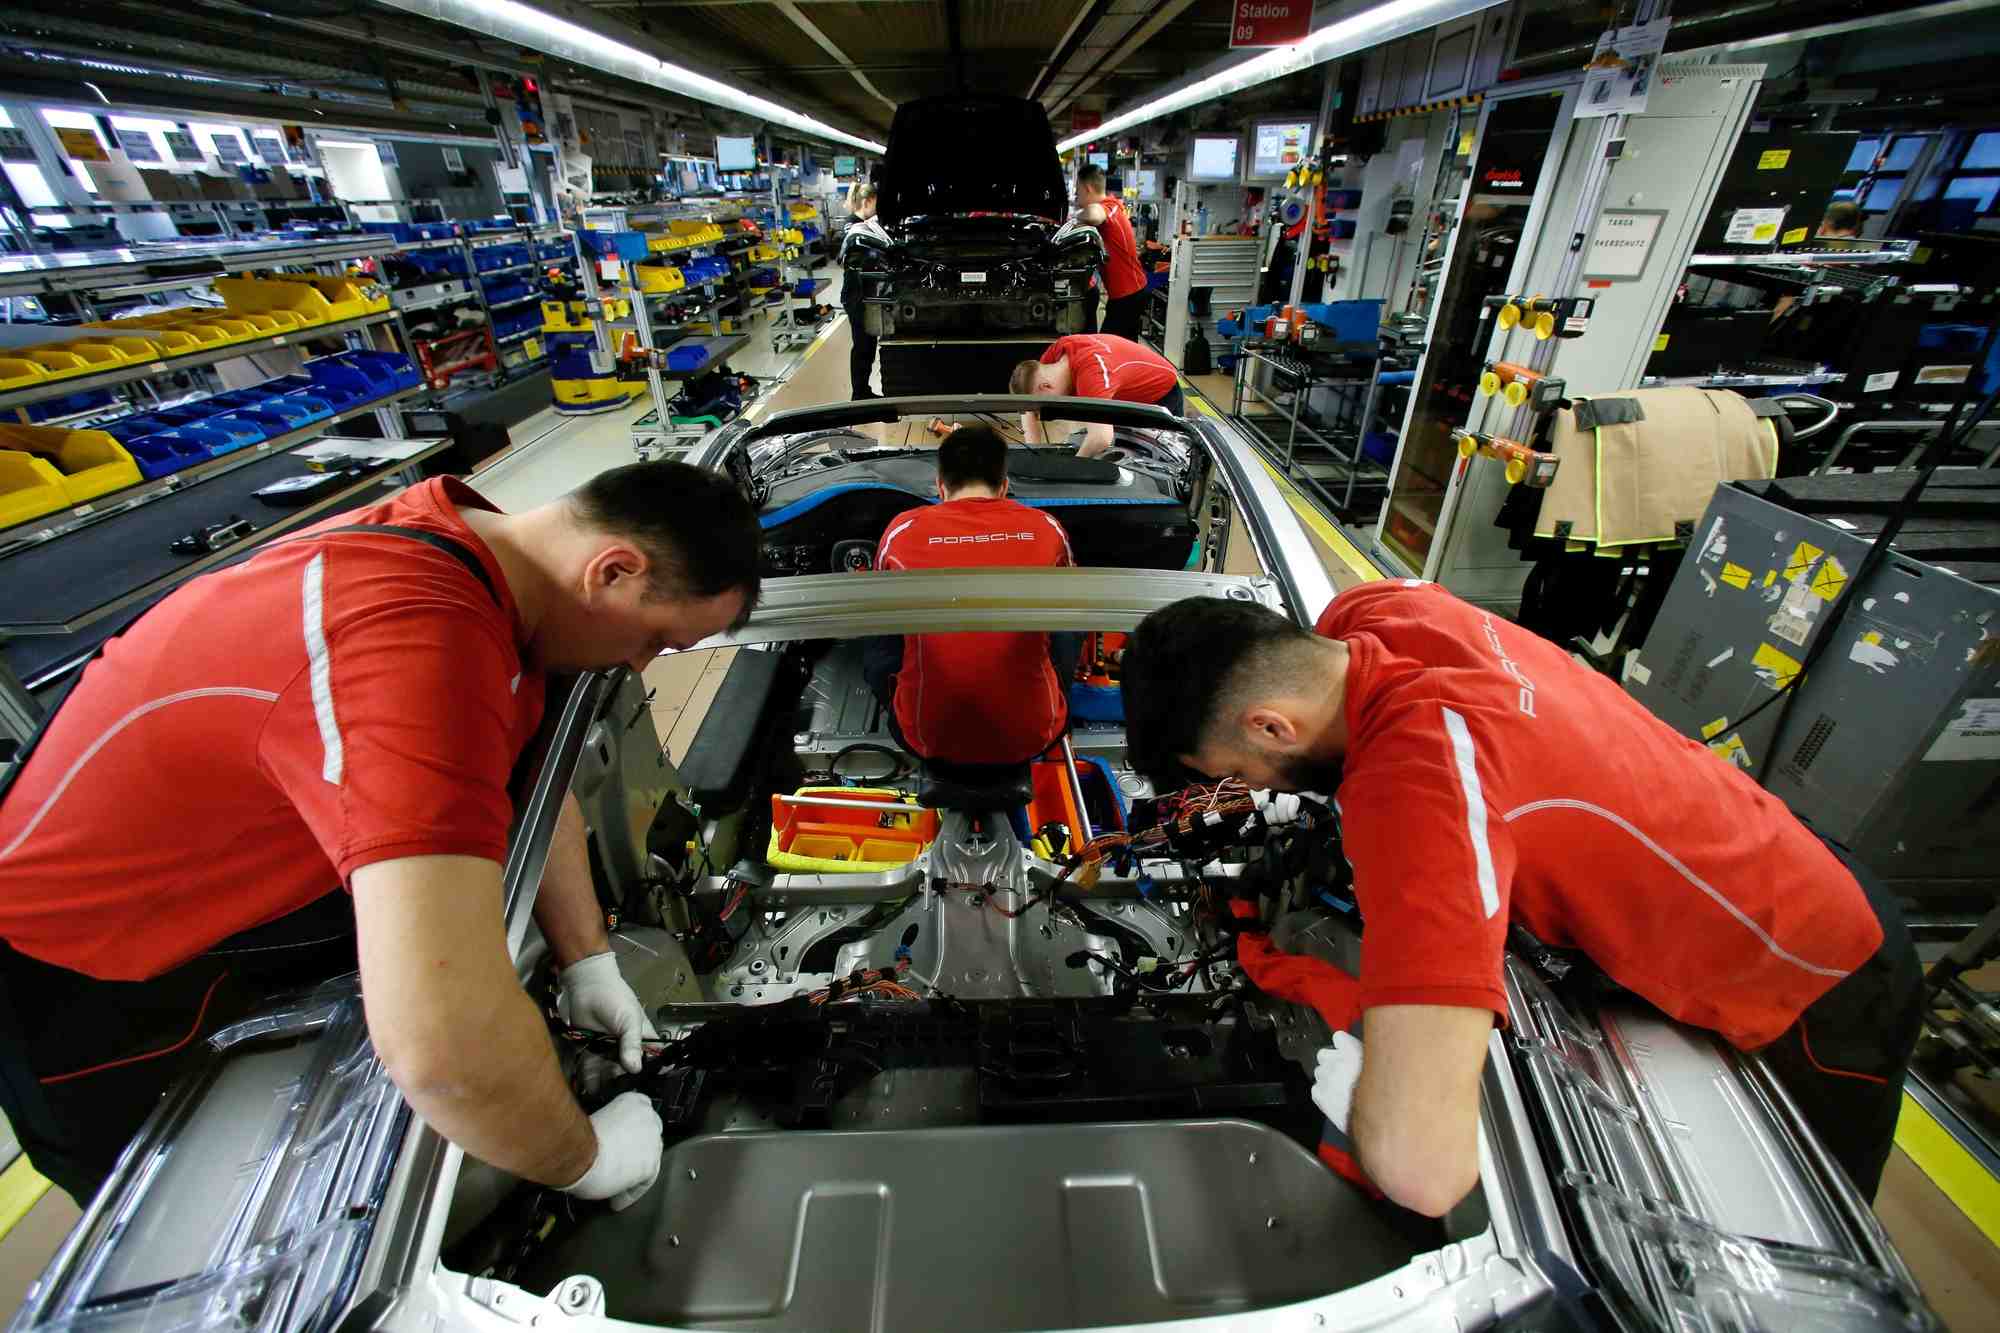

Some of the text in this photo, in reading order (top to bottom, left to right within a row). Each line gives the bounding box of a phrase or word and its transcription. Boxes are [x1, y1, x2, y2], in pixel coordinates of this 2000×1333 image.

[1240, 3, 1289, 18] Station
[1237, 25, 1254, 40] 09
[928, 532, 1036, 545] PORSCHE
